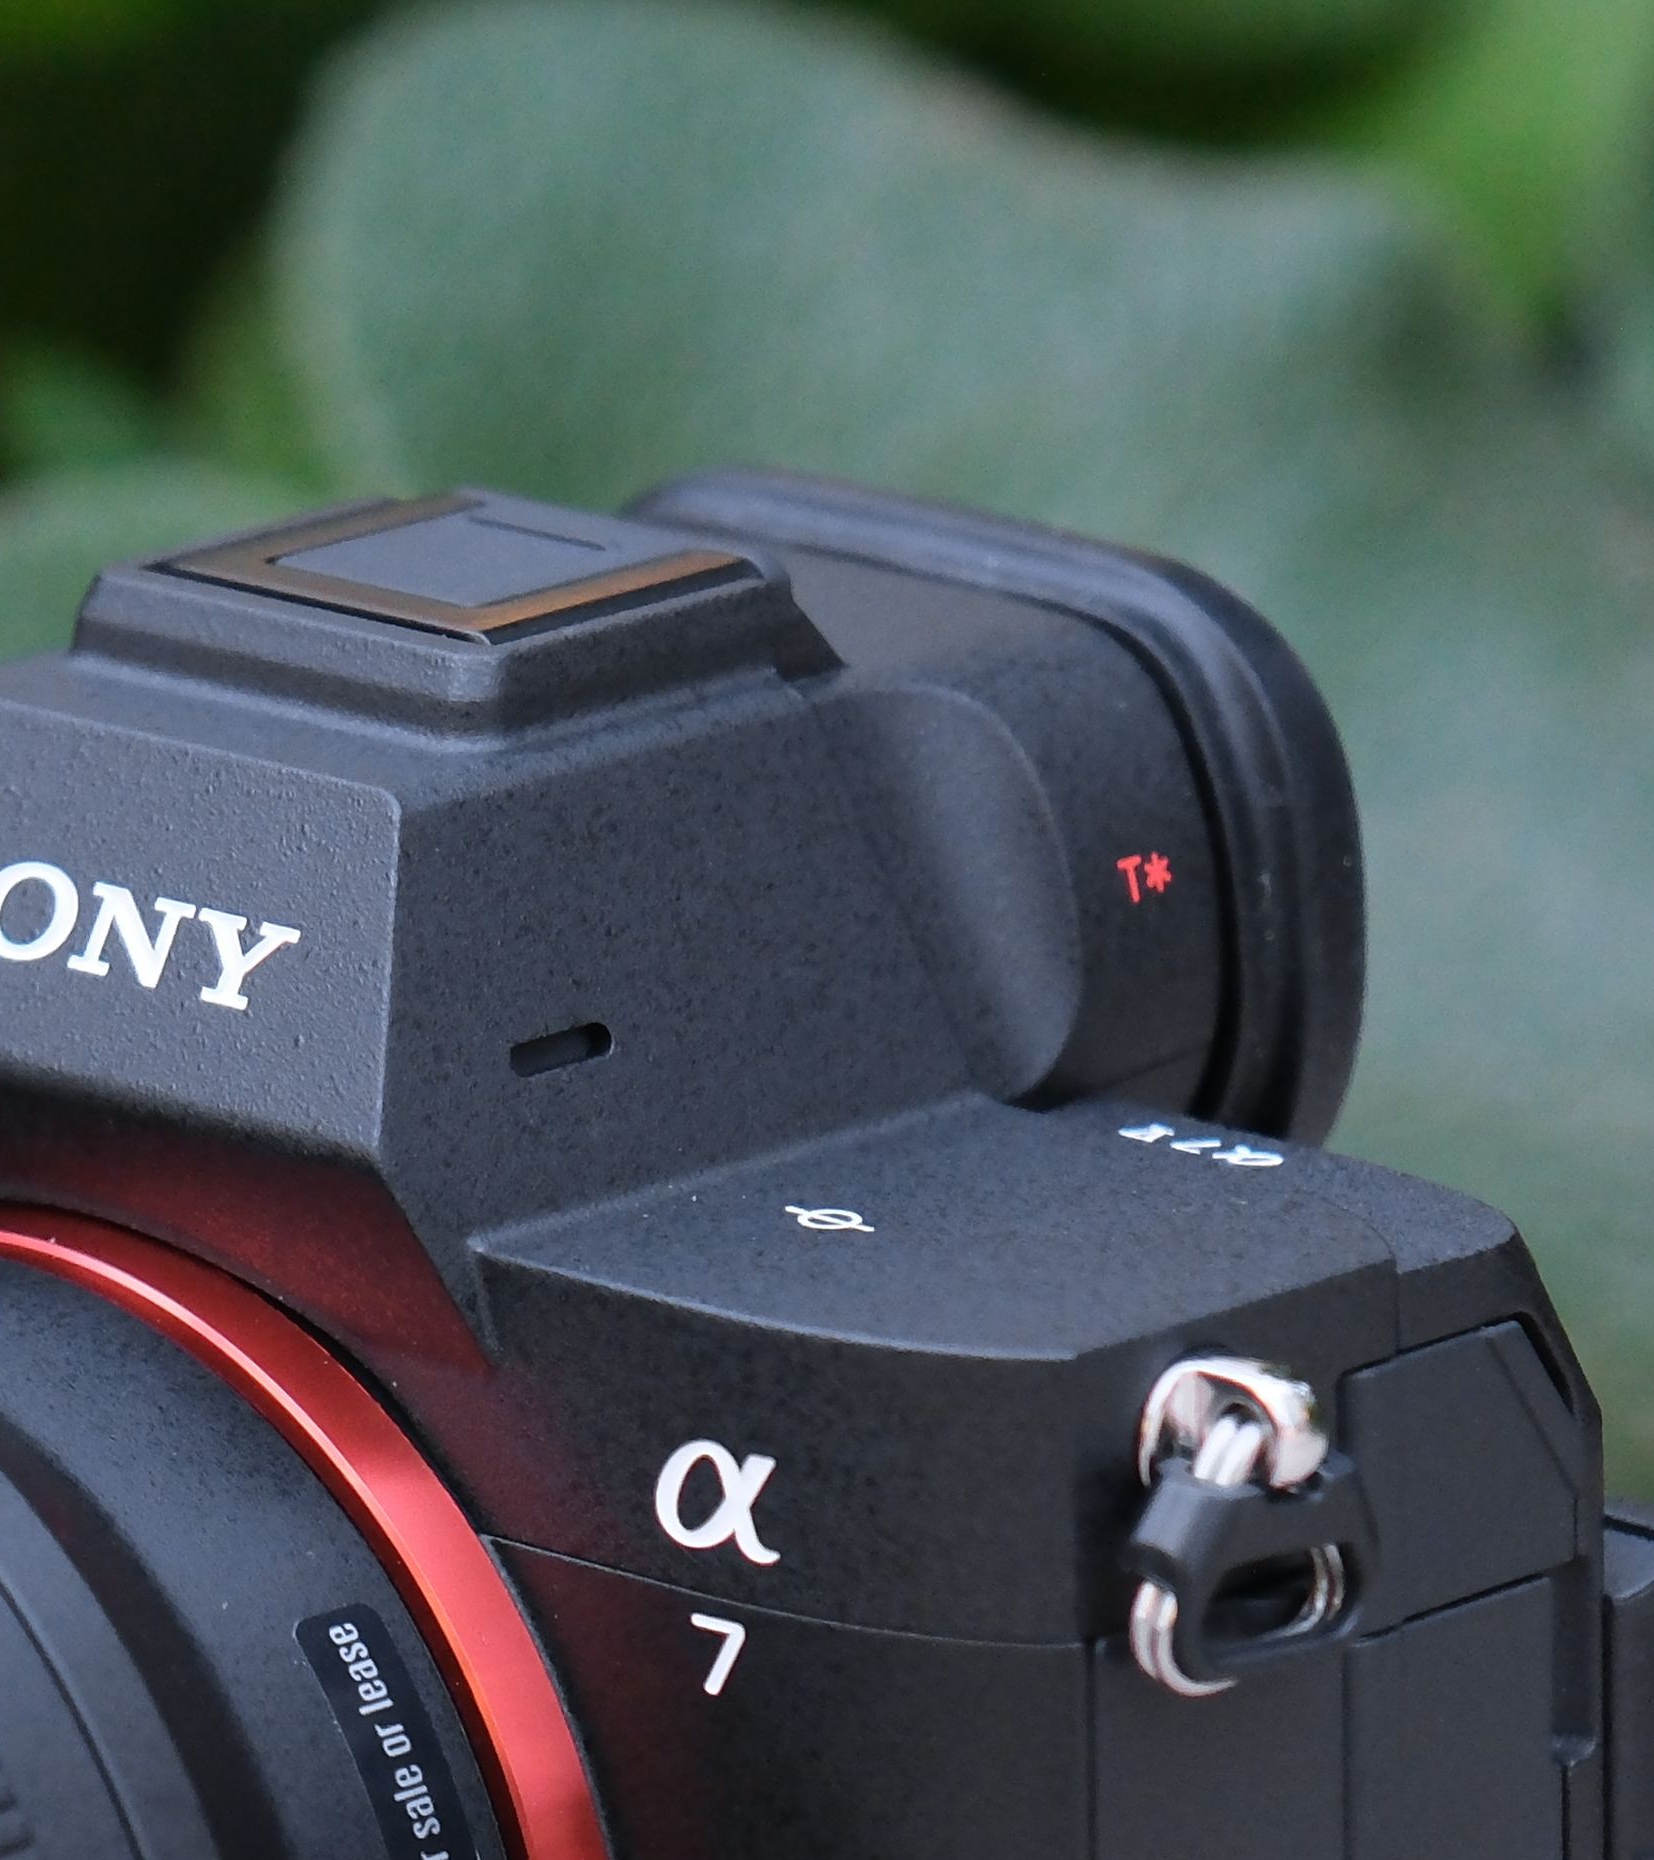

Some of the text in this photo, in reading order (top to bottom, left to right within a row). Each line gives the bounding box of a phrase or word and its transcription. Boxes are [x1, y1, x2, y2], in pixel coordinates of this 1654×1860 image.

[327, 1621, 395, 1717] lease
[689, 1612, 747, 1697] 7
[373, 1722, 413, 1759] or
[392, 1763, 442, 1840] sale
